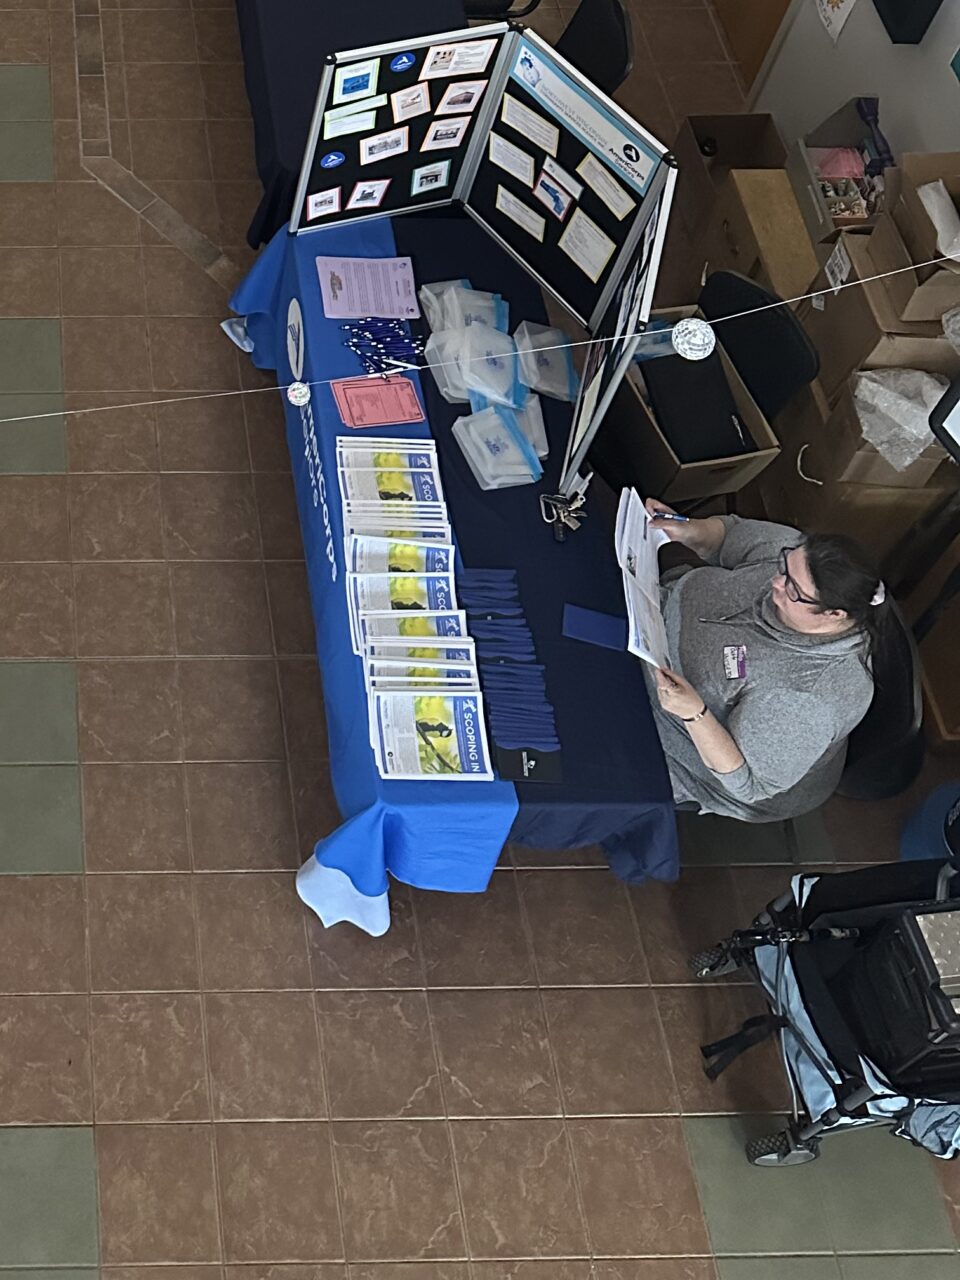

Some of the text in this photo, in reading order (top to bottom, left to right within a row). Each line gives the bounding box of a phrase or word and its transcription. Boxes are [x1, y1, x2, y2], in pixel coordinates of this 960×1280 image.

[608, 147, 645, 181] AmeriCorps
[306, 403, 338, 583] meriCorps
[463, 712, 481, 773] SCOPING IN
